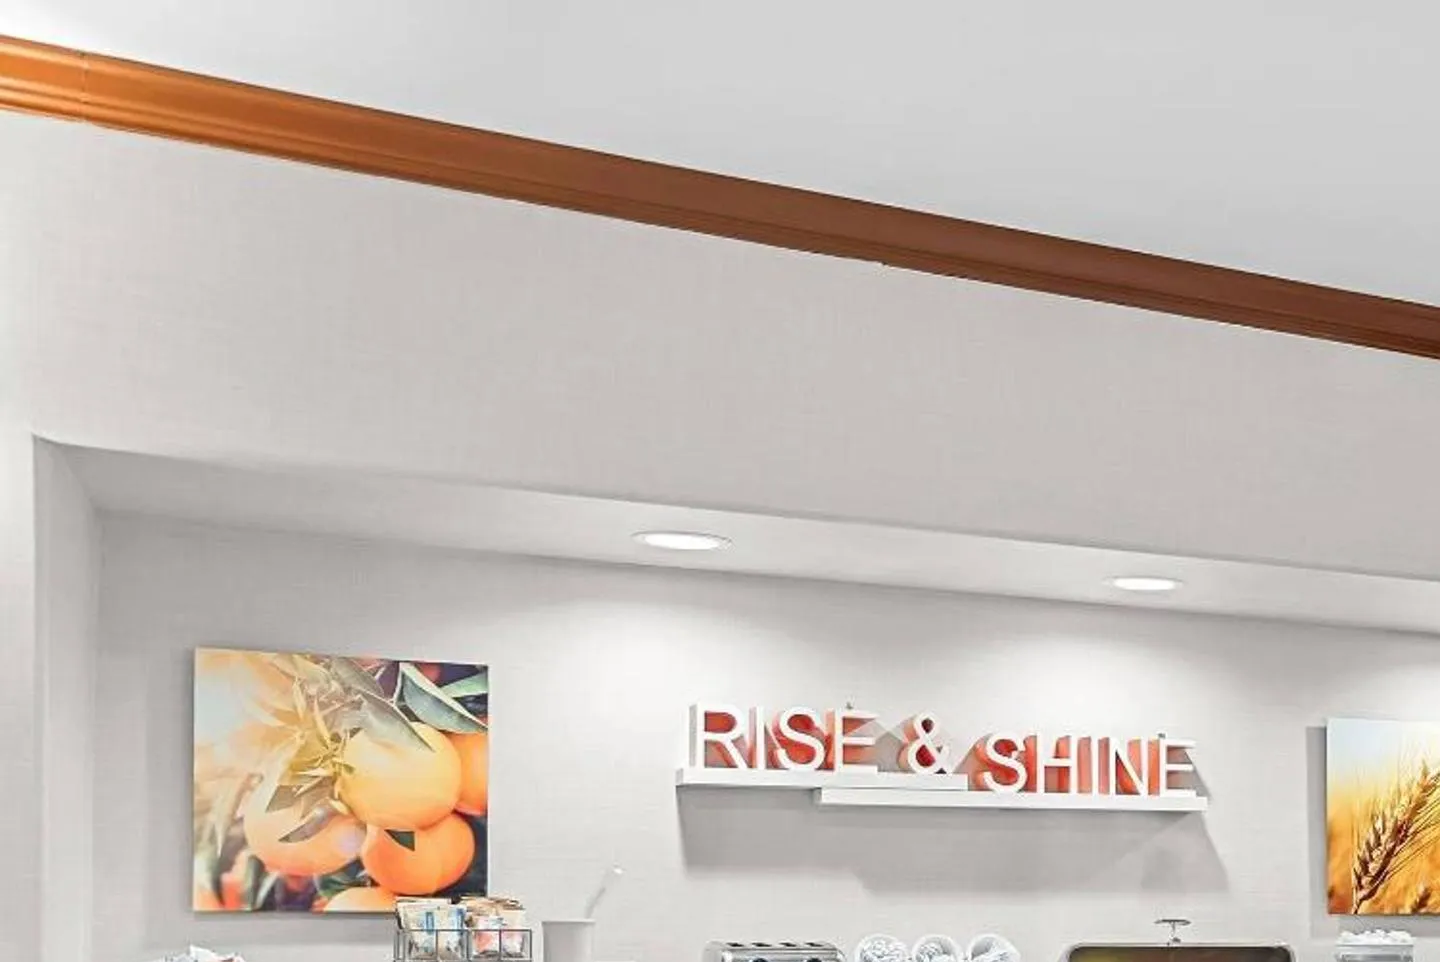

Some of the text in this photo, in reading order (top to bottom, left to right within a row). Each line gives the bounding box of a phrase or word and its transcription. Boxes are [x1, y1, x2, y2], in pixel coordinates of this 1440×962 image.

[690, 703, 1197, 798] RISE & SHINE
